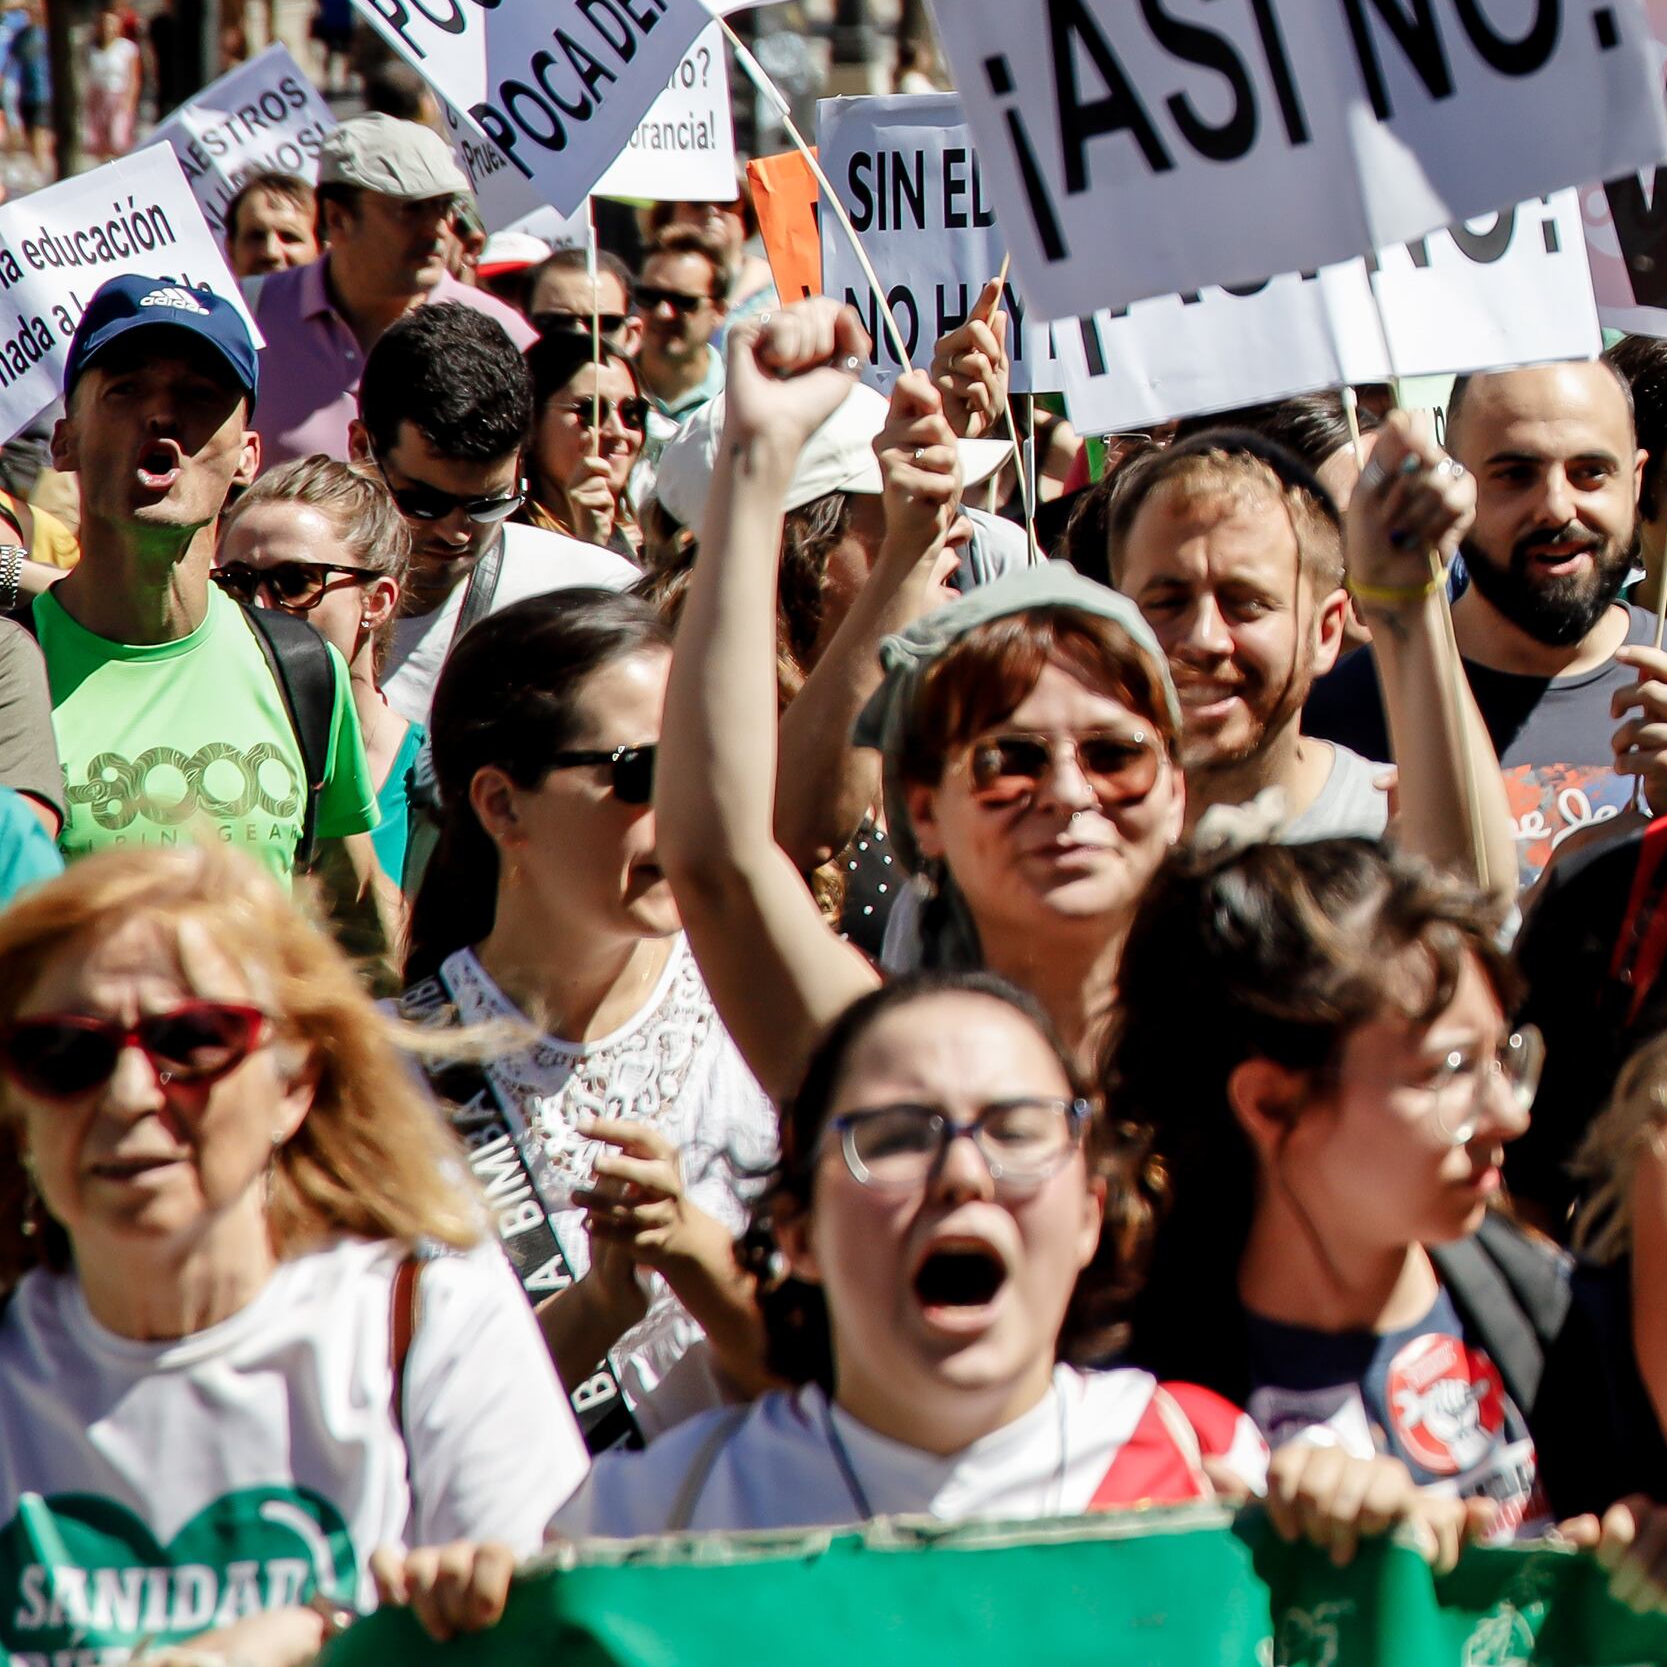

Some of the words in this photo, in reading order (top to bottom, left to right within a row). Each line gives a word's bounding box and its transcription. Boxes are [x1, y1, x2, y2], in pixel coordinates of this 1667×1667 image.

[467, 27, 619, 181] POCA
[666, 46, 711, 89] ro?
[179, 76, 309, 182] AESTROS
[849, 148, 926, 232] SIN
[21, 195, 176, 271] educación
[844, 283, 920, 367] NO
[16, 1560, 308, 1633] SANIDAD
